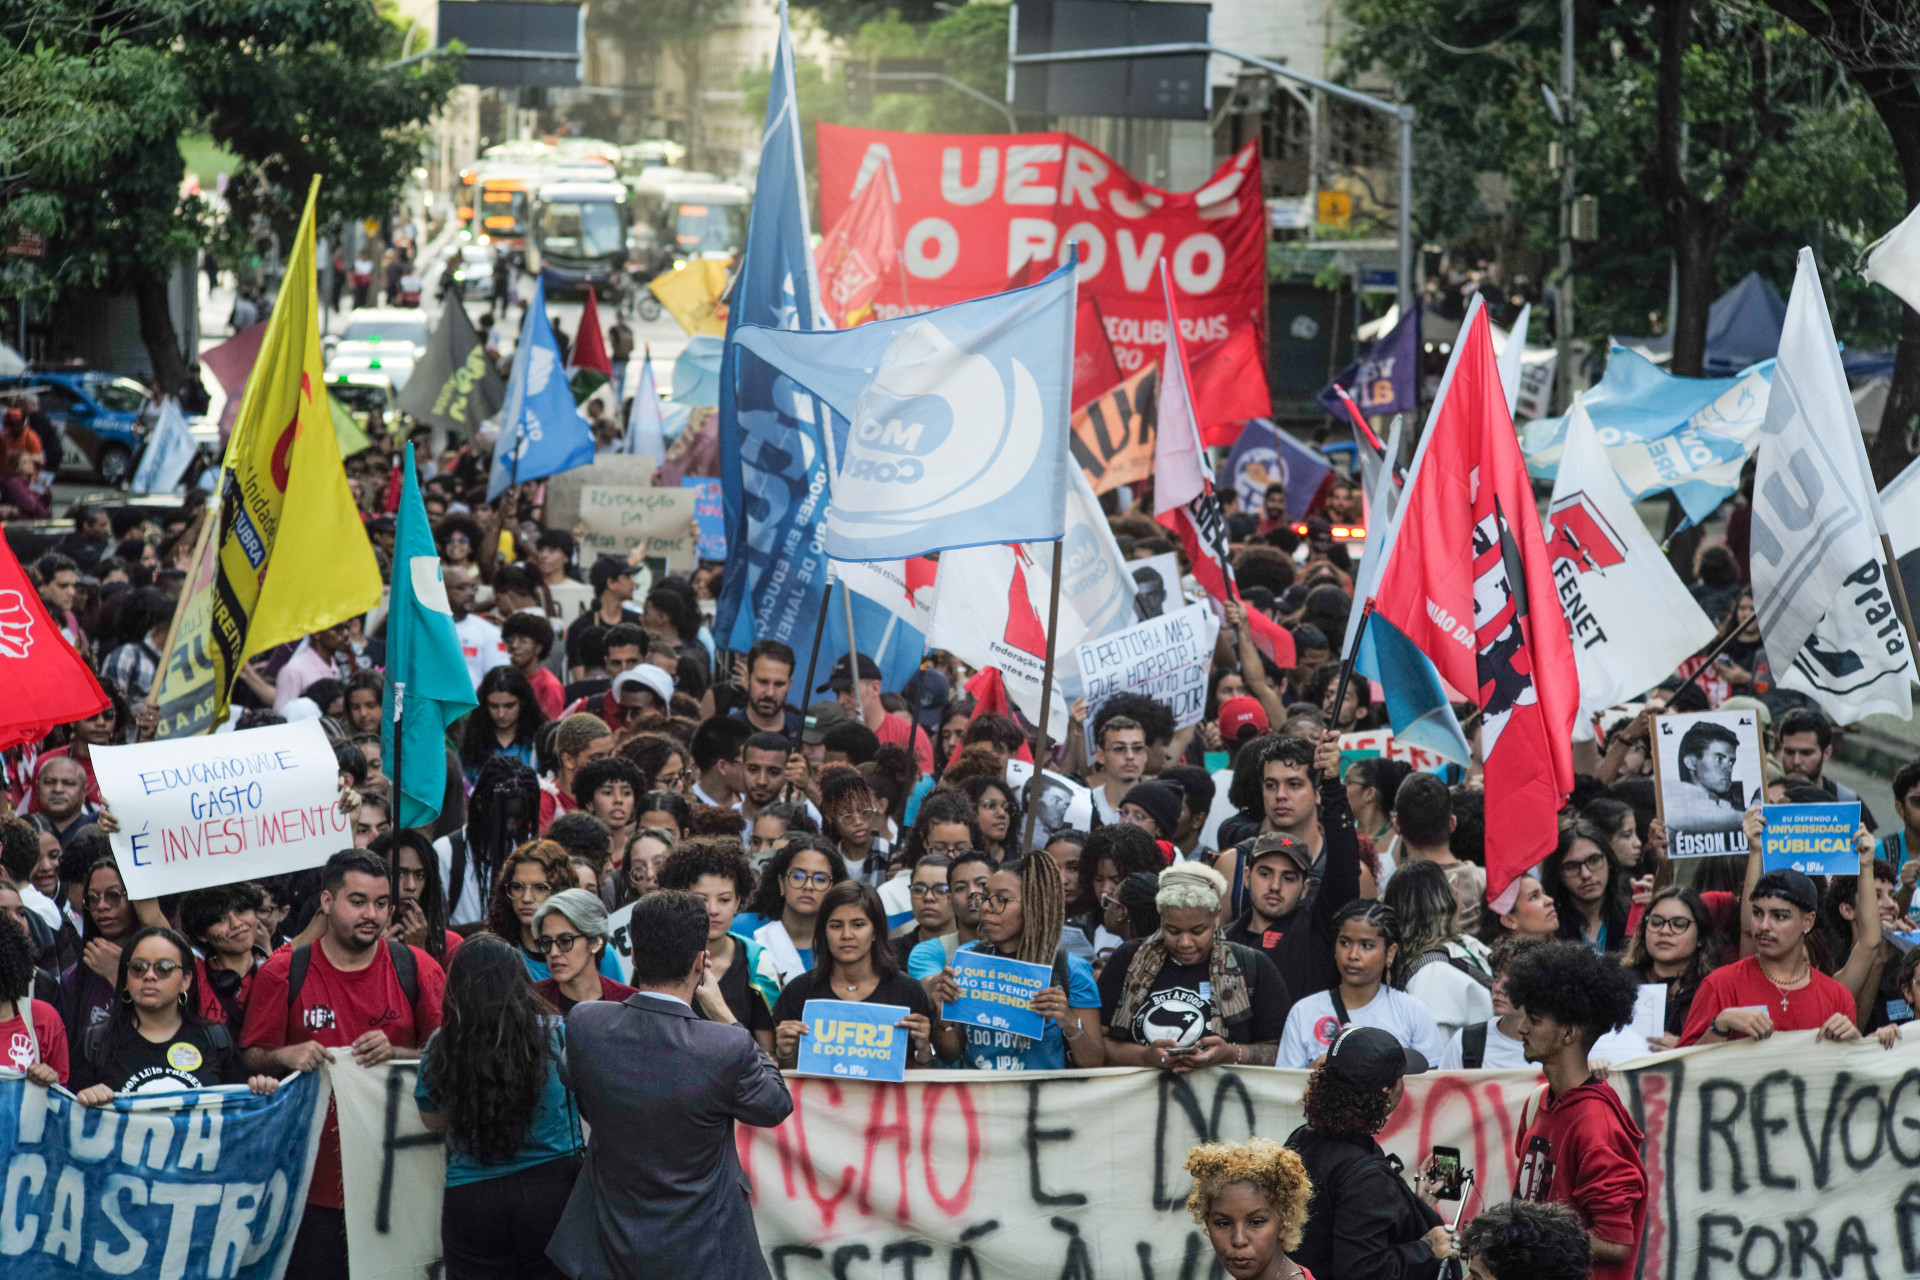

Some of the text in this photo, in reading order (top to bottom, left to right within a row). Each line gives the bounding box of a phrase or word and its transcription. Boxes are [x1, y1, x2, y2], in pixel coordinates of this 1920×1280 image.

[1007, 217, 1226, 294] POVO
[1553, 559, 1608, 650] FENET
[1164, 615, 1194, 646] MAS
[1452, 625, 1476, 650] DA
[1025, 673, 1039, 685] em
[1089, 672, 1121, 700] QUE
[1767, 824, 1851, 834] UNIVERSIDADE
[1794, 815, 1829, 823] DEFENDO
[131, 800, 347, 867] É INVESTIMENTO
[1675, 830, 1725, 855] ÉDSON
[1766, 831, 1851, 854] PÚBLICA!
[955, 965, 1043, 989] O QUE É PÚBLICO
[981, 981, 996, 990] SE
[1151, 991, 1205, 1008] BOTAFOGO
[814, 1018, 894, 1048] UFRJ
[974, 1030, 991, 1046] DO
[813, 1041, 892, 1060] É DO POVO!
[0, 1153, 289, 1280] CASTRO
